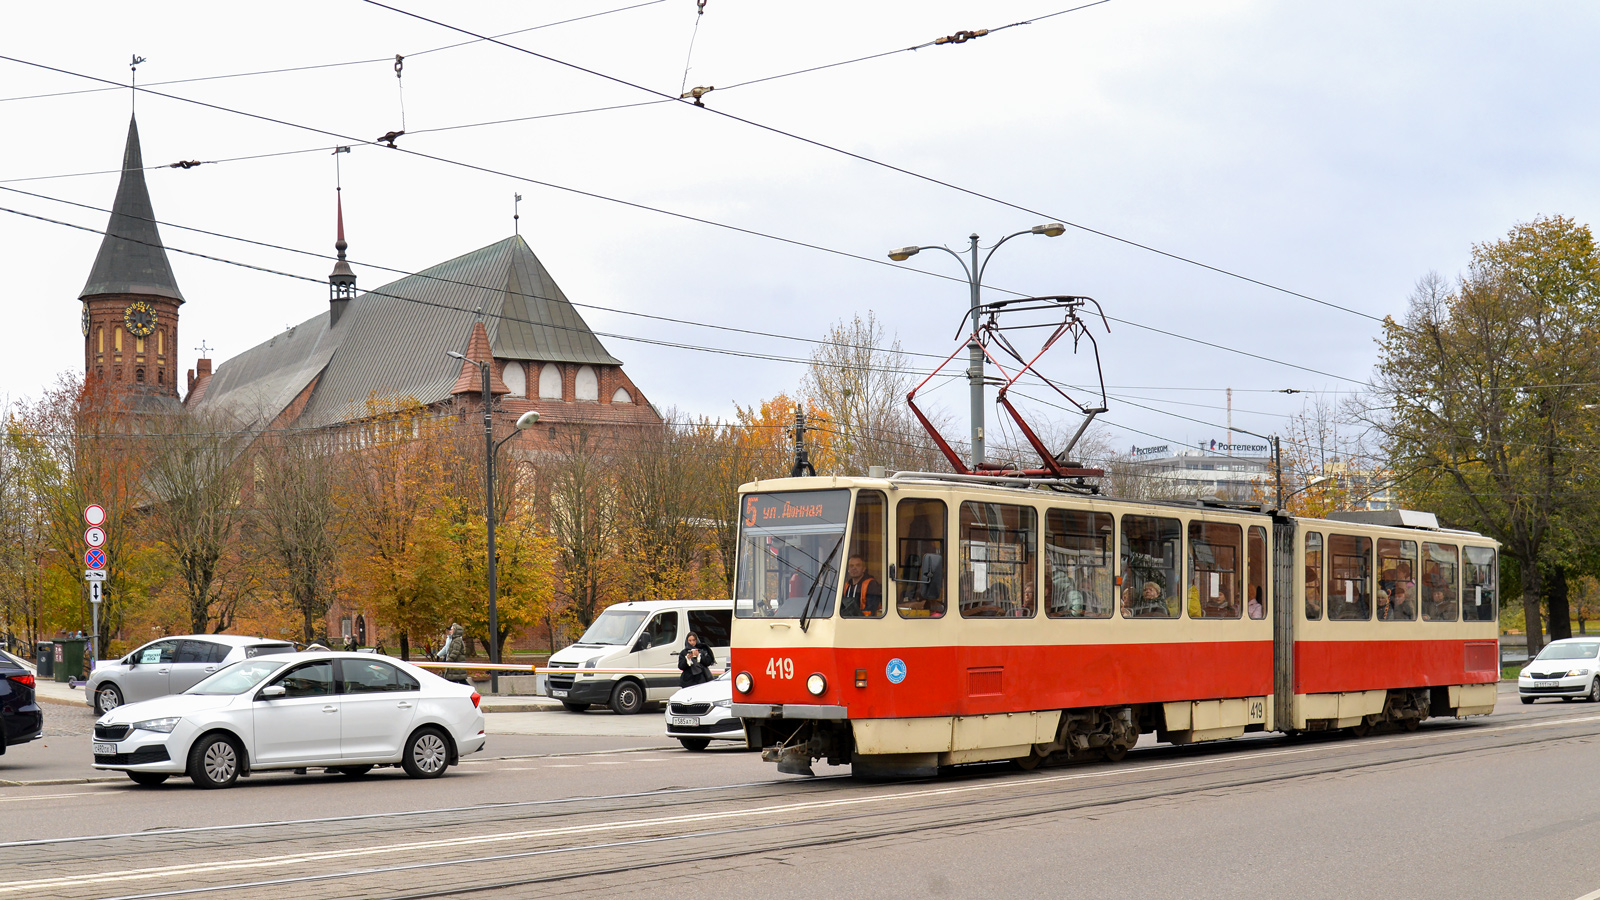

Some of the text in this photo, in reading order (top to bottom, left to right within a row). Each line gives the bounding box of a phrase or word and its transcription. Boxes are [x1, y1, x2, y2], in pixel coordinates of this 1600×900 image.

[1136, 445, 1168, 455] Ростелеком
[1218, 442, 1267, 452] Ростелеком
[745, 497, 758, 527] 5
[92, 533, 99, 542] 5
[766, 657, 794, 680] 419
[1250, 702, 1263, 718] 419
